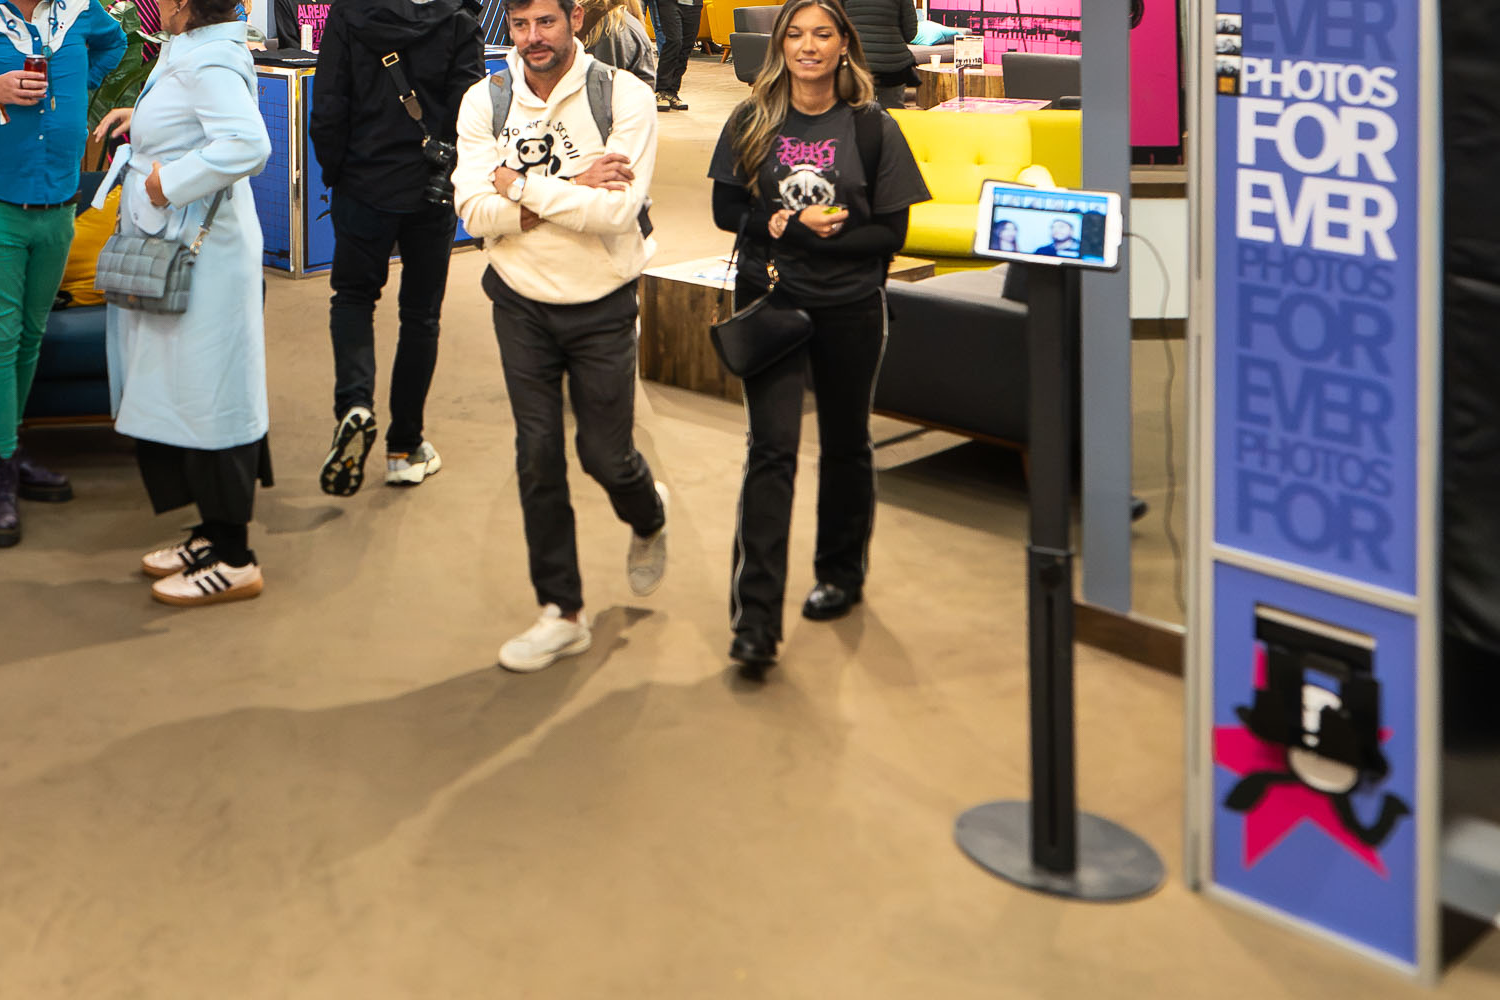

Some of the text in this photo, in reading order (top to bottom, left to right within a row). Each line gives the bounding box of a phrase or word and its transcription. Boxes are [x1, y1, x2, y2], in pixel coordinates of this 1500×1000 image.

[297, 3, 332, 19] ALREAD
[1240, 56, 1399, 108] PHOTOS
[1236, 97, 1399, 183] FOR
[1236, 168, 1399, 261] EVER
[1237, 244, 1395, 302] PHOTOS
[1237, 283, 1395, 378] FOR
[1237, 354, 1395, 456] EVER
[1236, 428, 1394, 499] PHOTOS
[1236, 468, 1394, 573] FOR
